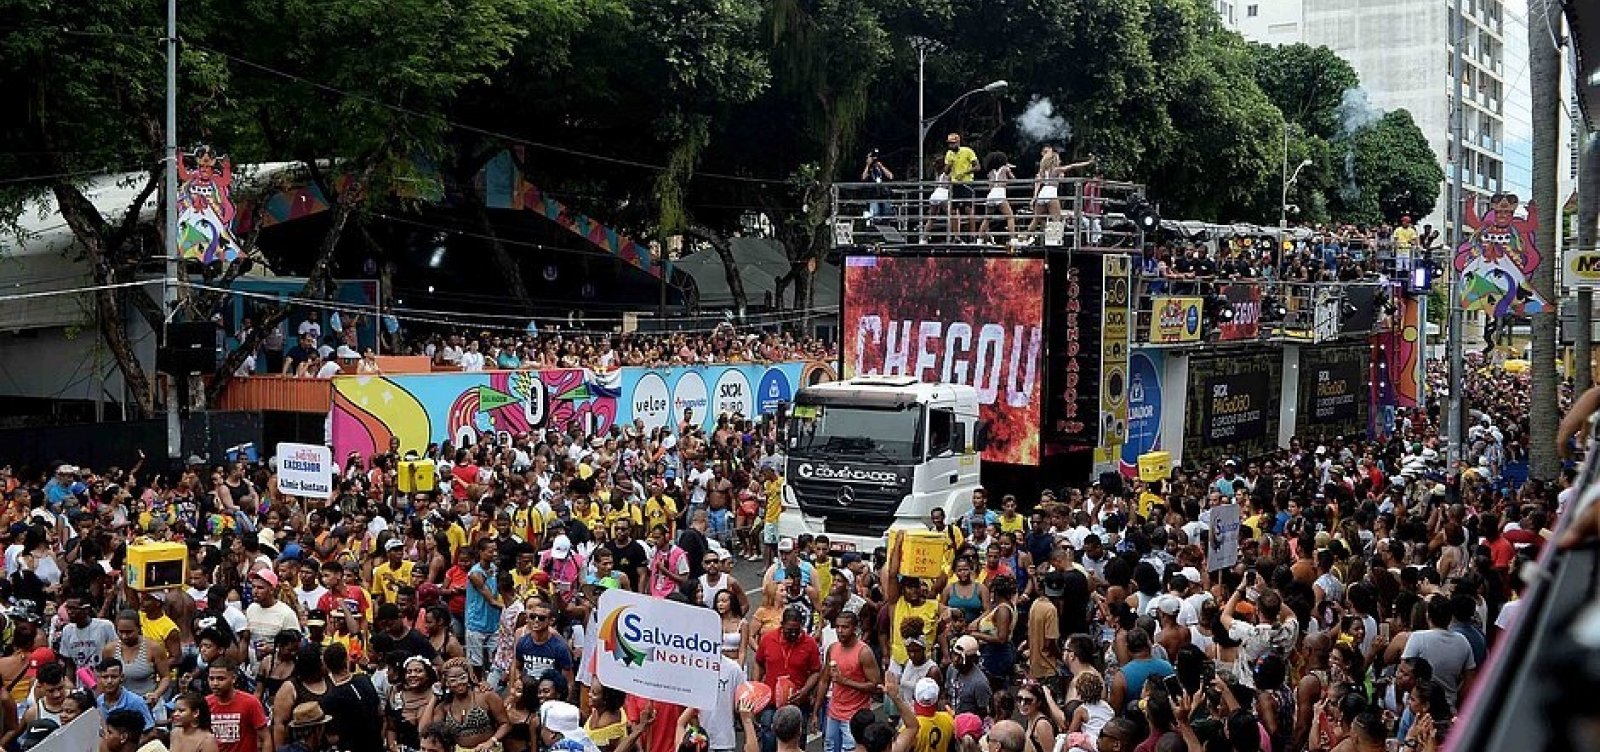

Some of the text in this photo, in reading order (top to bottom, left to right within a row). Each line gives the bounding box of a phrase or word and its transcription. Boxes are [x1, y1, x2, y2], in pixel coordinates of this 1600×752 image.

[855, 314, 1042, 408] CHEGOU
[636, 396, 667, 412] veloe
[624, 613, 720, 655] Salvador
